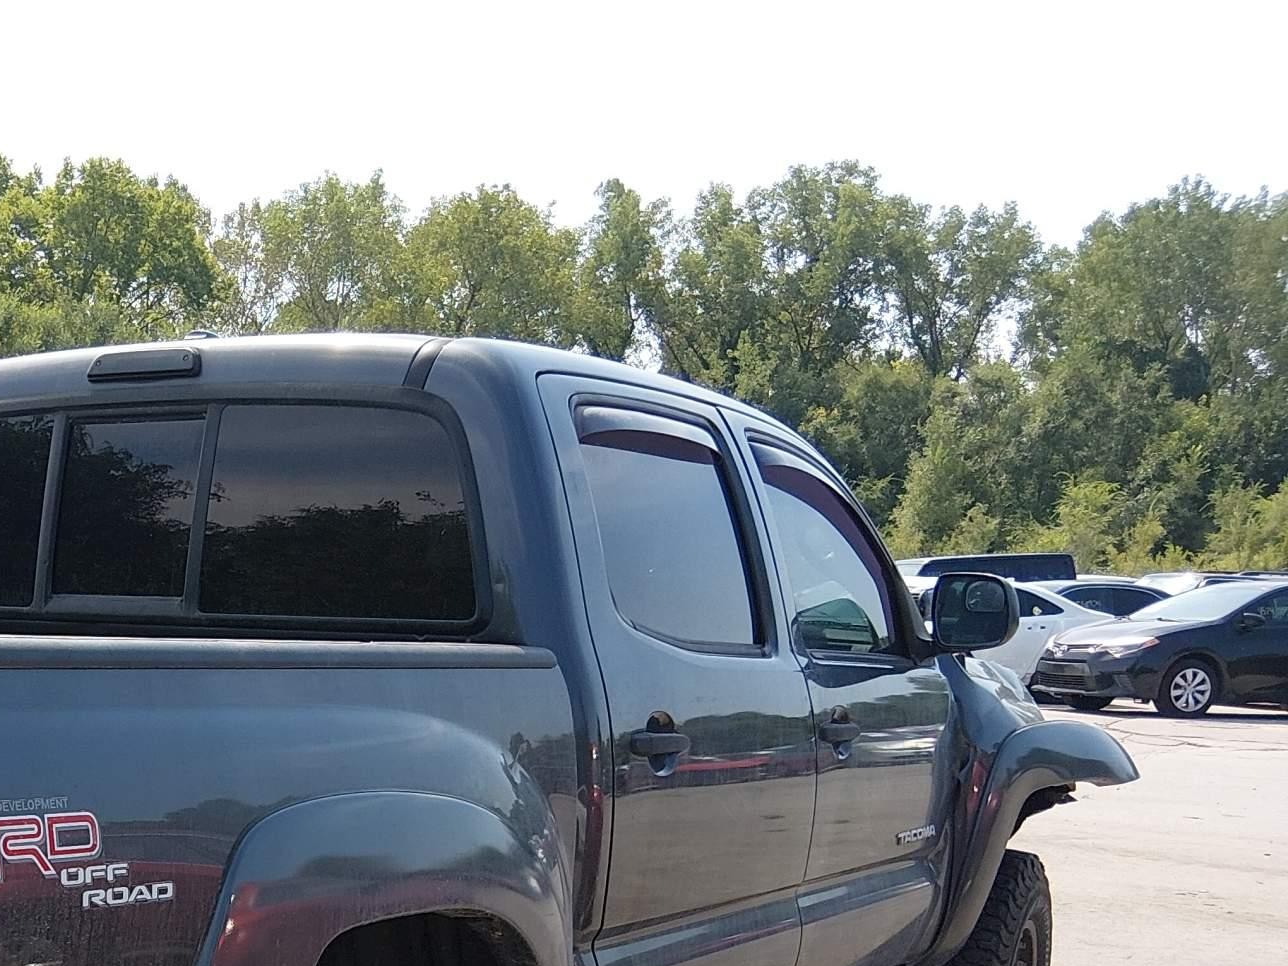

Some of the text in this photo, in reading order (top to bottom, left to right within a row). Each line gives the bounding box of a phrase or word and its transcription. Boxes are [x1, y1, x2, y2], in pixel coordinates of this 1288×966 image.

[897, 824, 936, 845] TACOMA
[60, 862, 130, 887] OFF
[81, 882, 175, 909] ROAD
